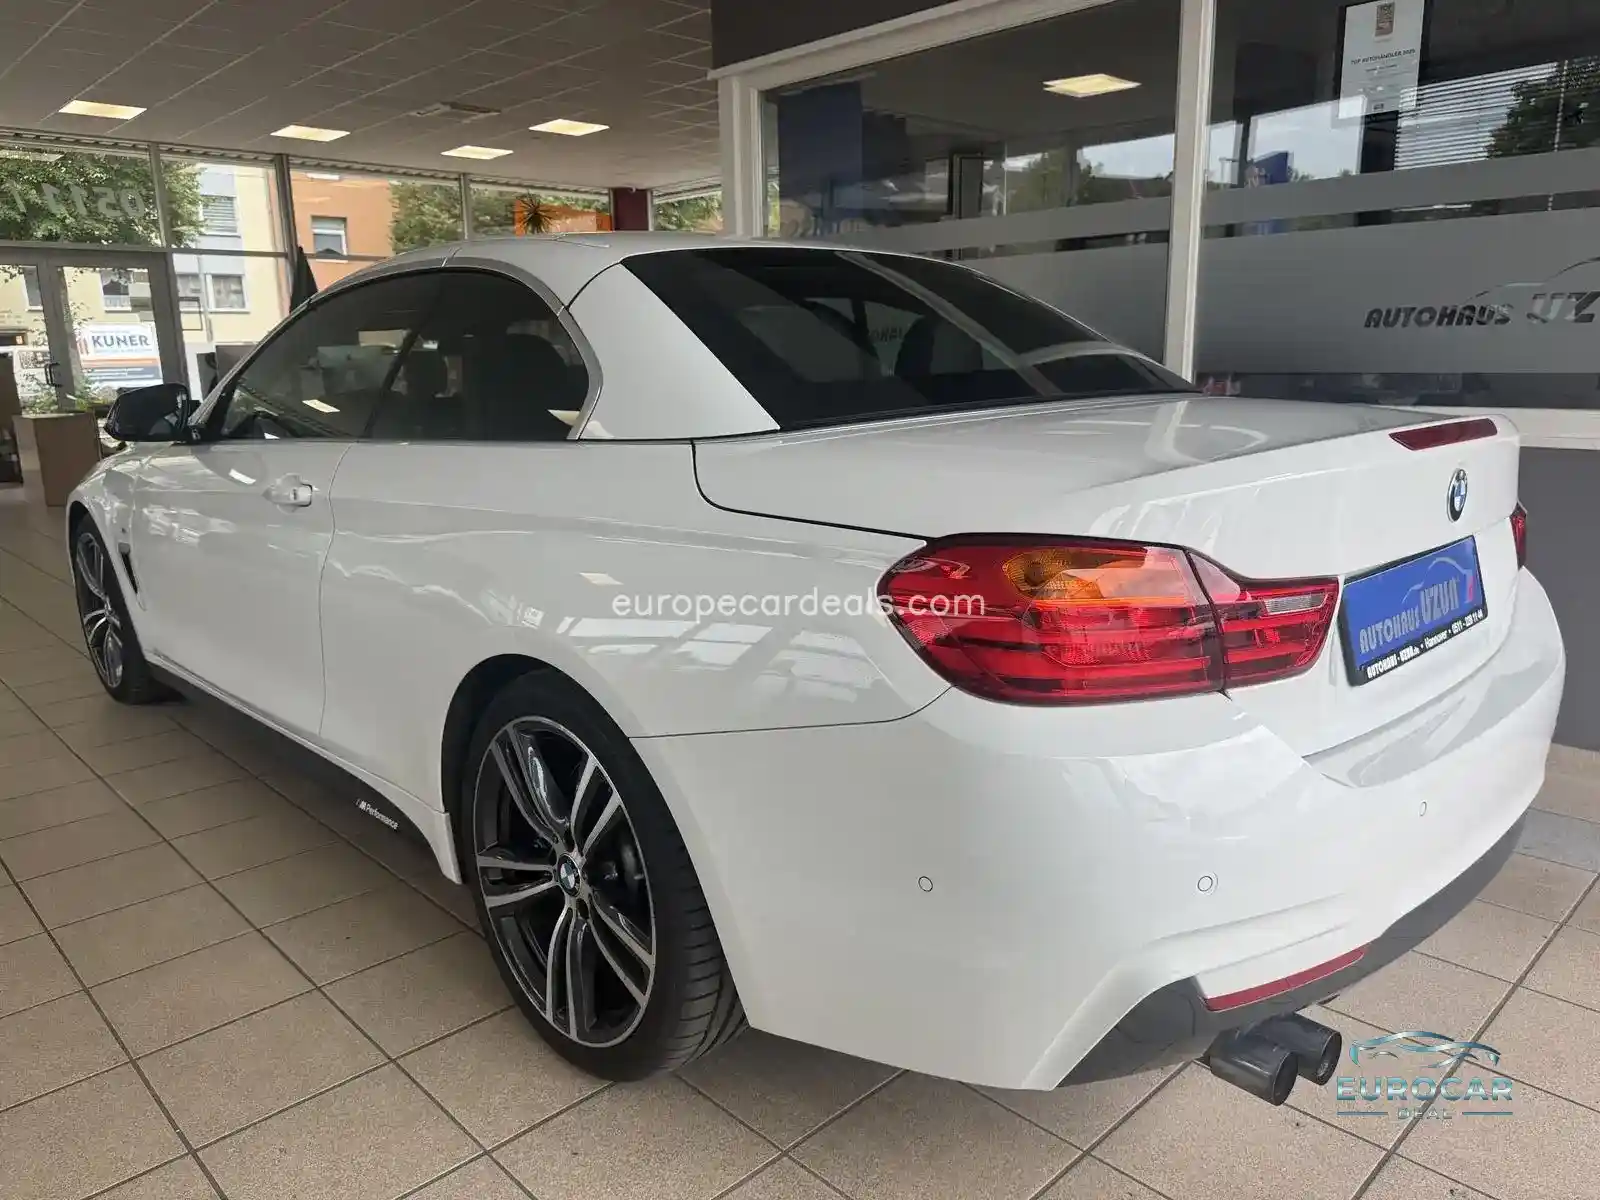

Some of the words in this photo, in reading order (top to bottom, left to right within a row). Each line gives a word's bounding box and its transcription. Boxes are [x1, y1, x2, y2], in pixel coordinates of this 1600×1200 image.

[1364, 303, 1514, 329] AUTOHAUS
[91, 334, 152, 348] KUNER
[1360, 603, 1420, 653] AUTOHAUS
